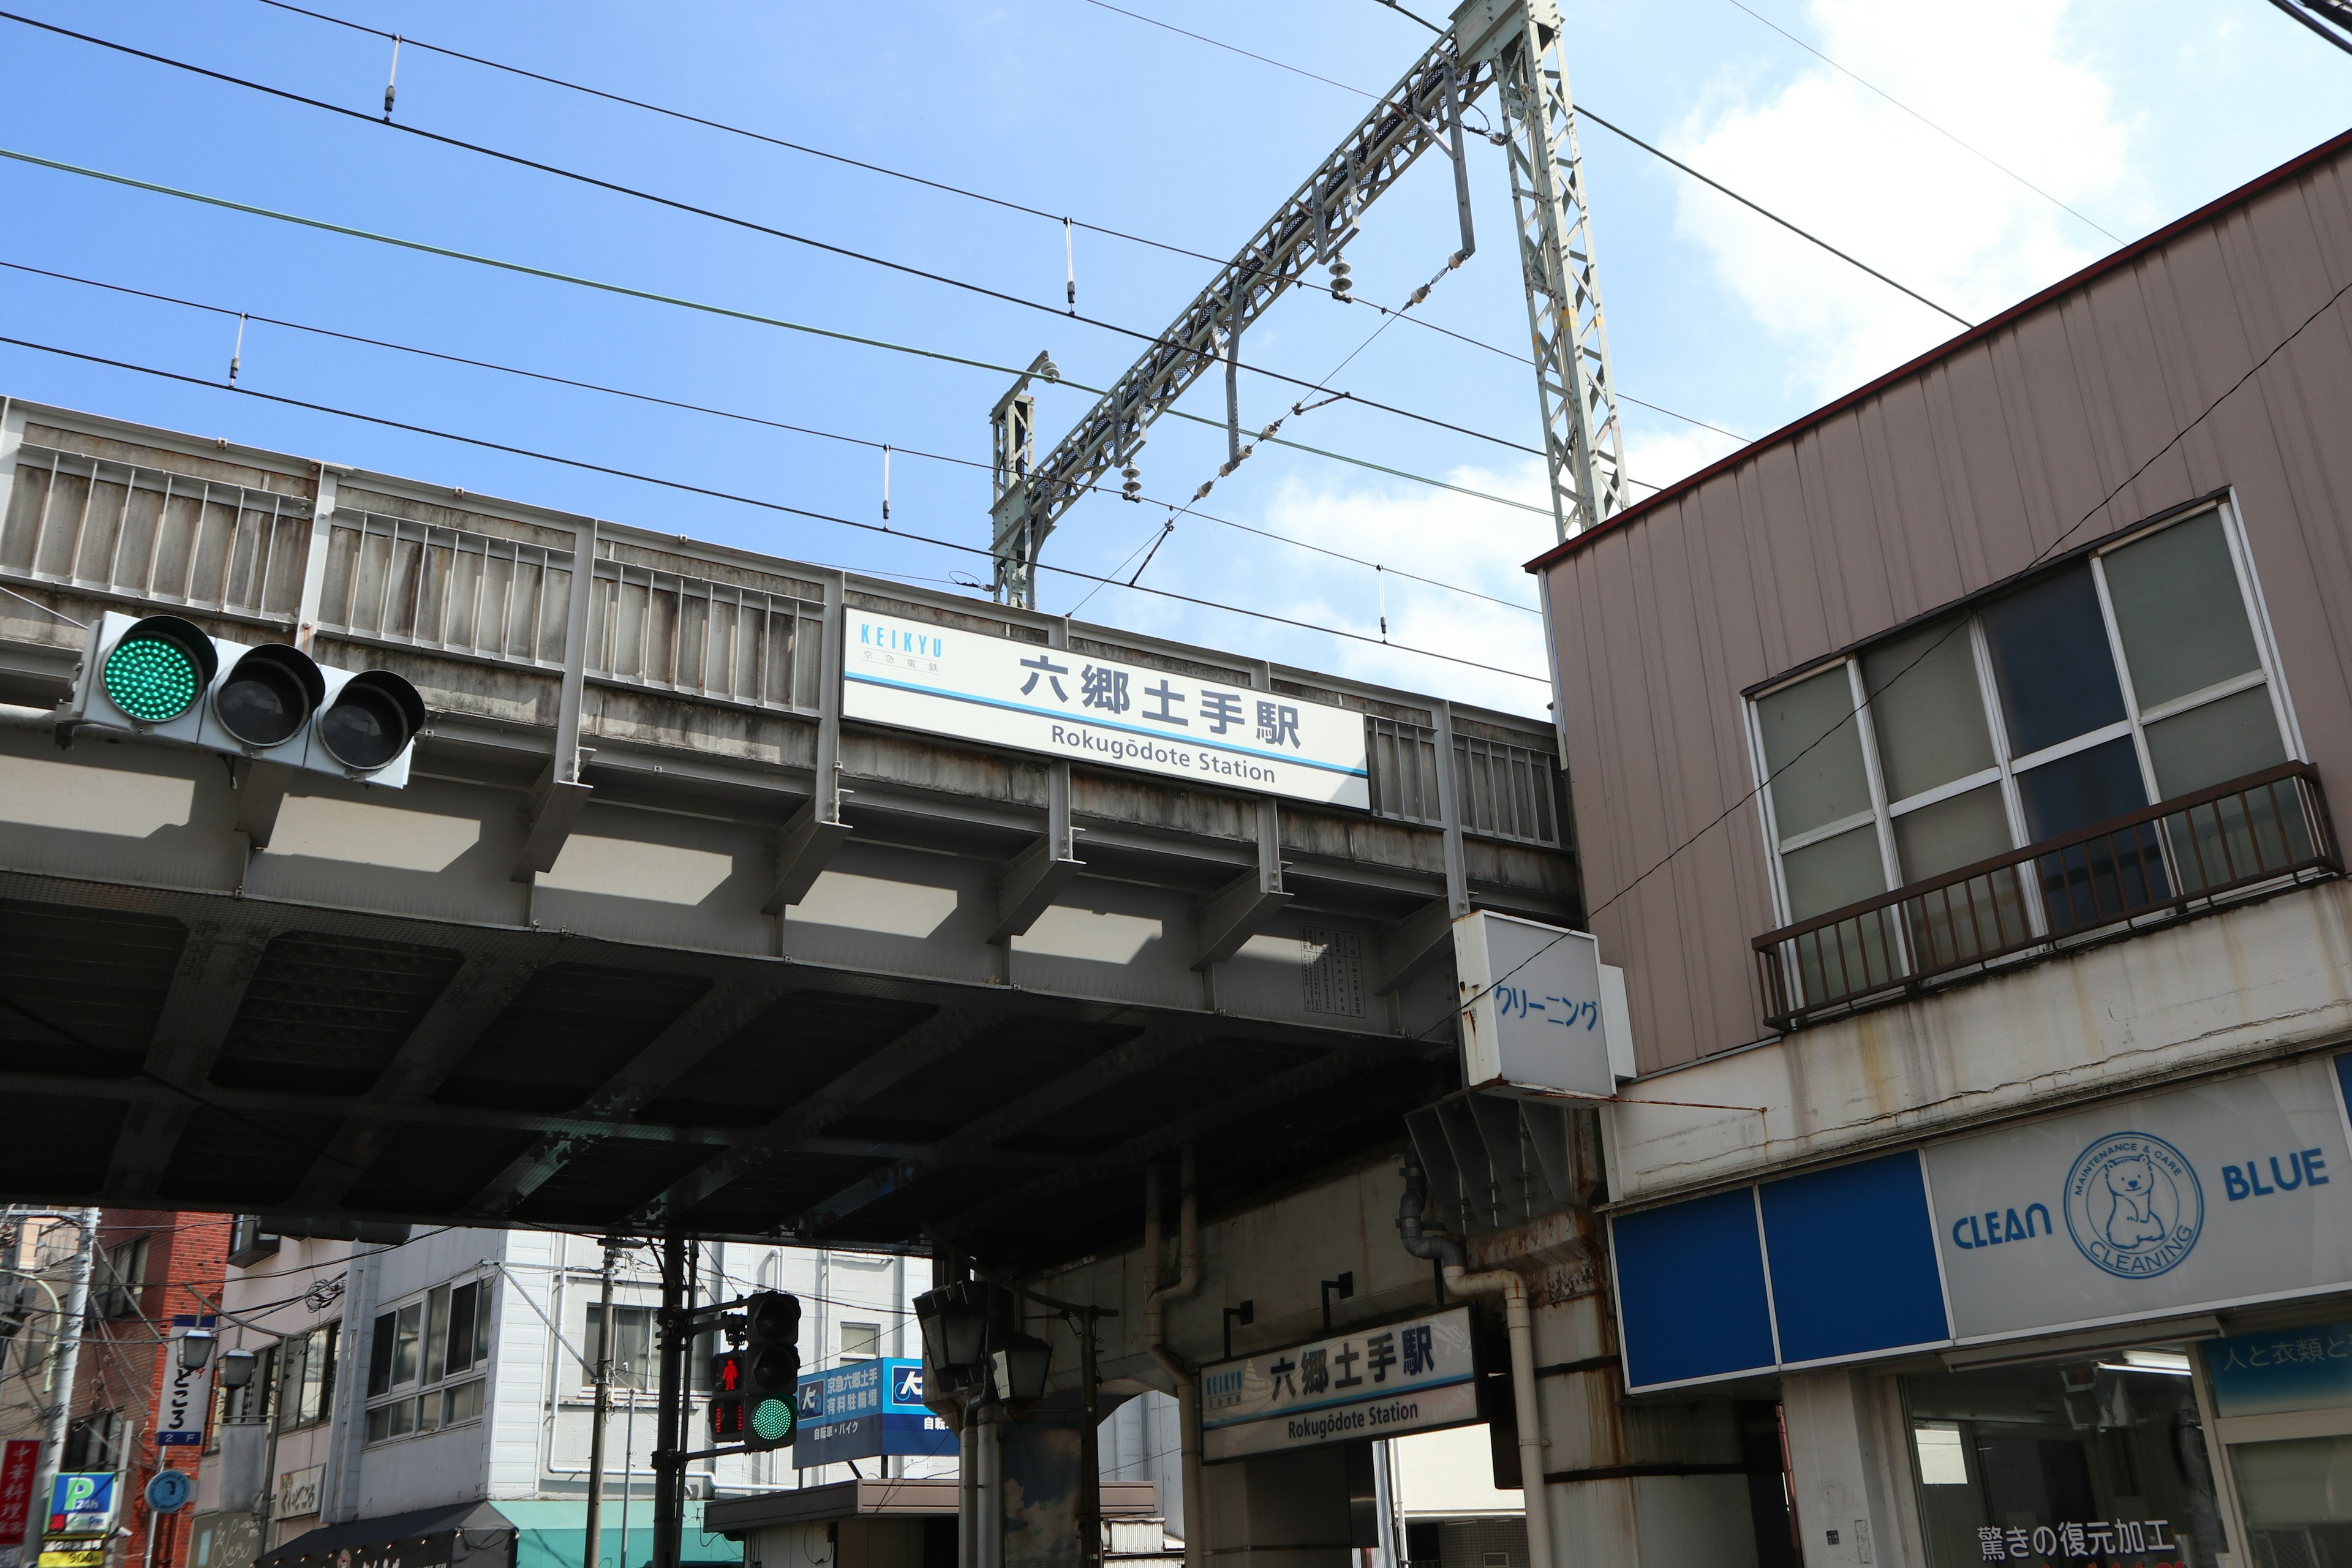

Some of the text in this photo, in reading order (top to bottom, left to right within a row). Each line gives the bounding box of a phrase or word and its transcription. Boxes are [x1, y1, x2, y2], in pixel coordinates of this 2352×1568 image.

[861, 624, 941, 658] KEIKYU
[863, 650, 940, 672] 京急電鉄
[1019, 655, 1301, 749] 六郷土手駅
[1050, 725, 1275, 784] Rokugōdote Station
[1495, 984, 1597, 1031] クリーニング
[2074, 1142, 2182, 1196] MAINTENANCE & CARE
[1952, 1147, 2329, 1250] CLEAN BLUE
[2089, 1224, 2194, 1272] CLEANING
[826, 1366, 878, 1394] 京急六郷土手
[1270, 1325, 1435, 1402] 六郷土手駅
[1207, 1371, 1242, 1395] KEIKYU
[826, 1389, 878, 1416] 有料駐輪場
[1288, 1401, 1419, 1439] Rokugōdote Station
[813, 1420, 859, 1441] 自転車・バイク
[923, 1416, 950, 1431] 自転
[1, 1444, 30, 1520] 中華料理
[63, 1477, 95, 1511] P
[75, 1499, 99, 1510] 24h
[1977, 1517, 2176, 1562] 驚きの復元加工
